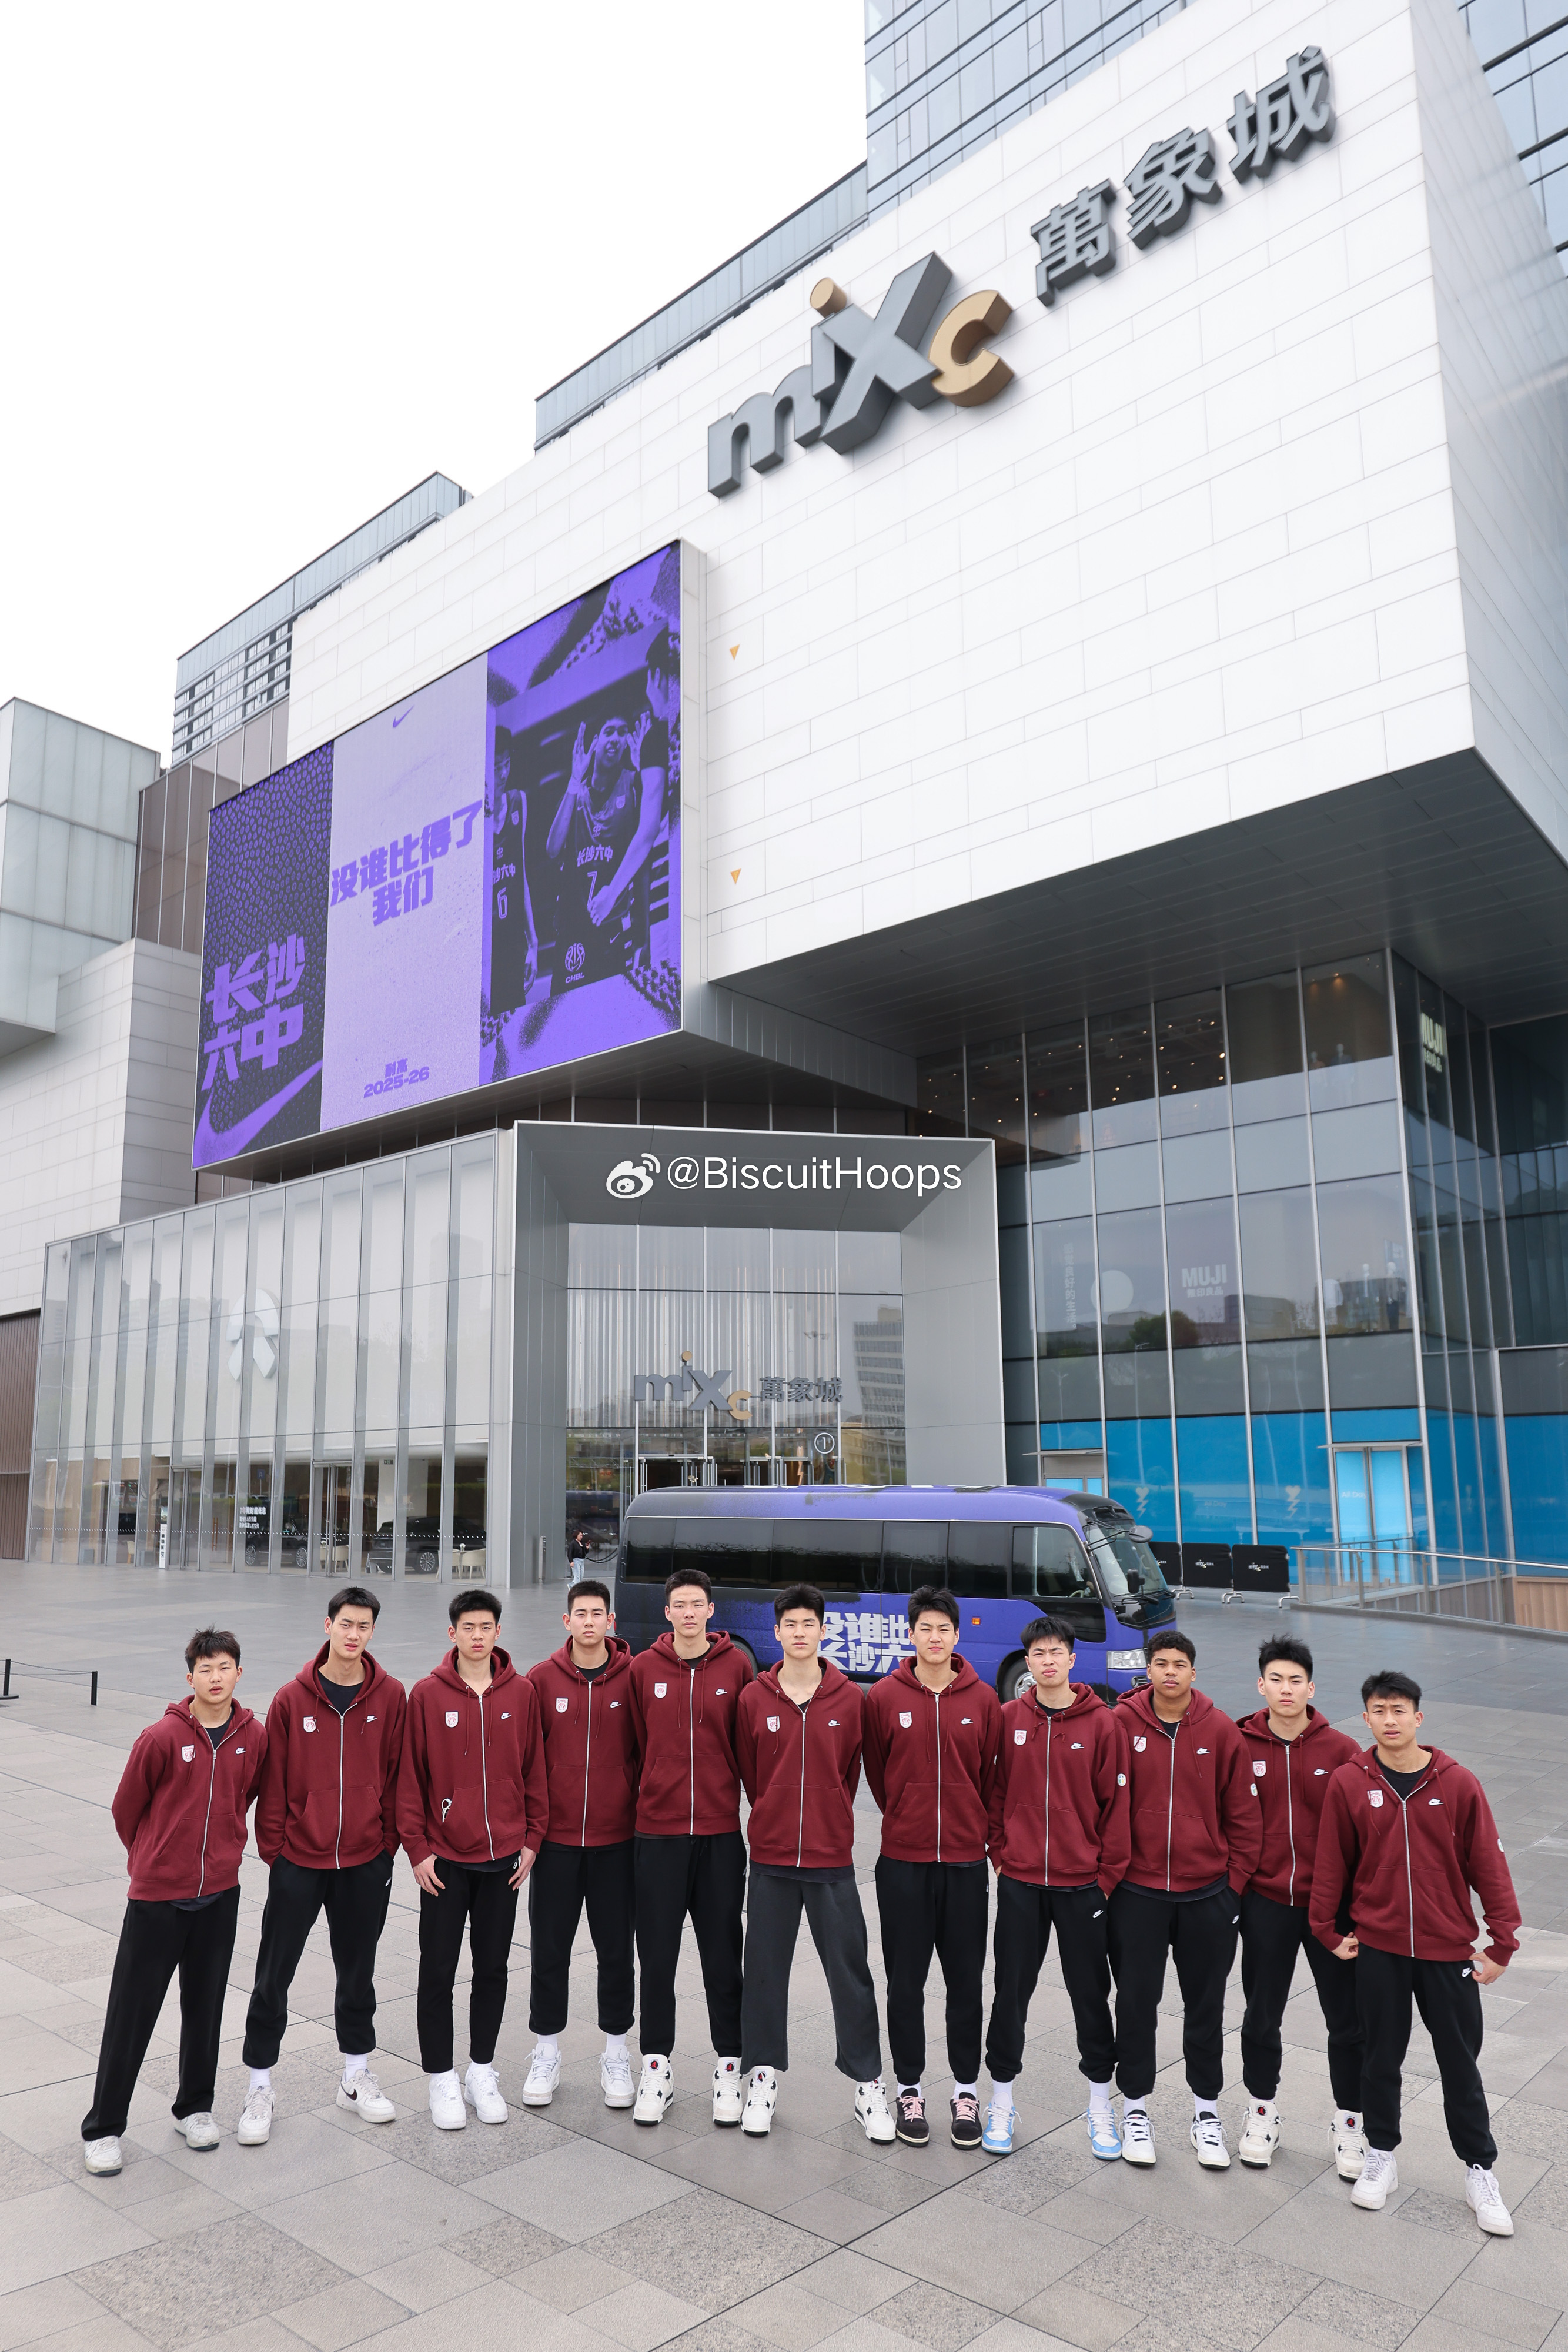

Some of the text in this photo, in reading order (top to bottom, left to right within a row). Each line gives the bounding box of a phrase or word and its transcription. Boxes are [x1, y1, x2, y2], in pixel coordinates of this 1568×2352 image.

[1029, 45, 1336, 307] 萬象城
[330, 799, 483, 907] 没谁比得了
[577, 844, 613, 867] 长沙六中
[373, 866, 434, 927] 我们
[497, 887, 508, 920] 6
[206, 933, 305, 1023] 长沙
[565, 972, 585, 984] CHBL
[201, 1003, 304, 1091] 六中
[363, 1066, 430, 1098] 2025-26
[1182, 1264, 1227, 1288] MUJI
[759, 1376, 843, 1403] 萬象城
